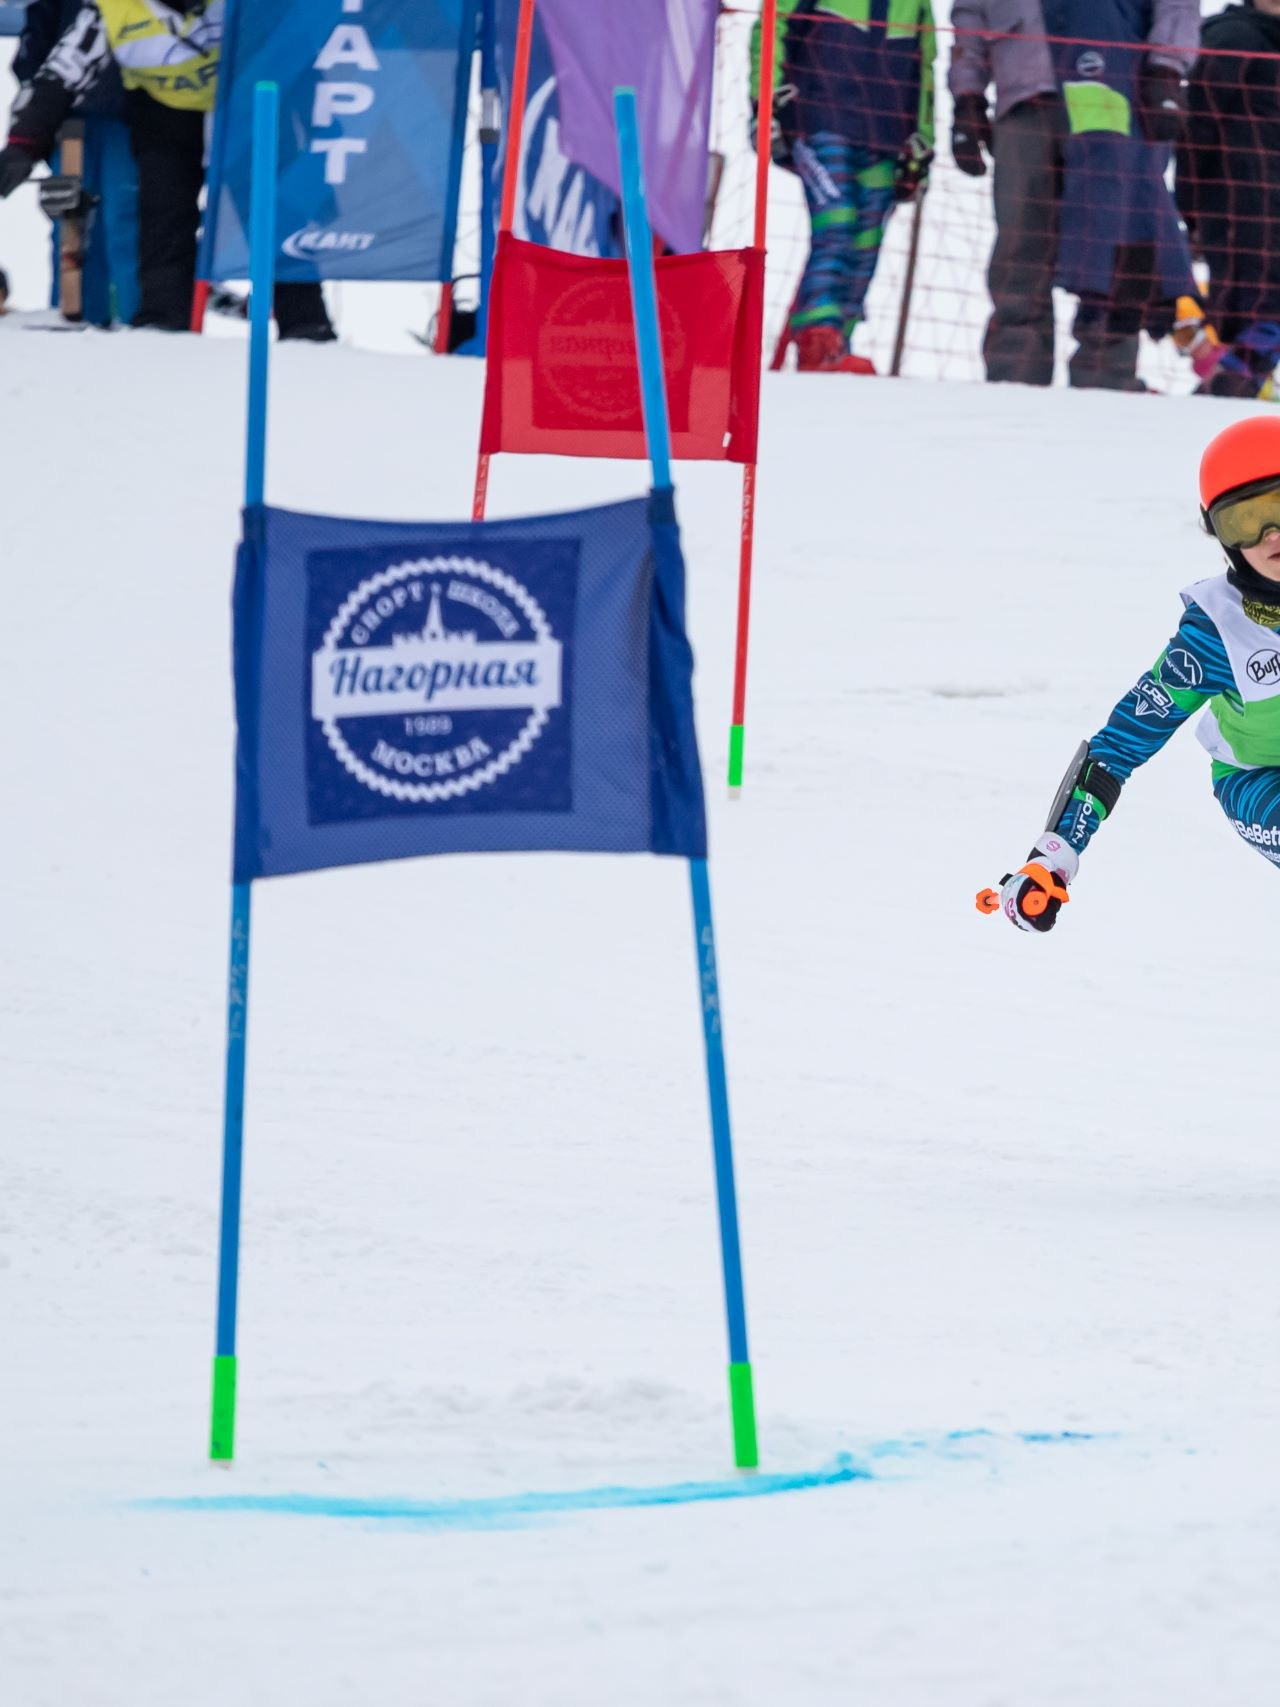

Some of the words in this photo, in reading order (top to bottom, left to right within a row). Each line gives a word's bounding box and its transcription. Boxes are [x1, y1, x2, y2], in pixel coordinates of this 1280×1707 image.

[311, 0, 382, 185] АРТ
[329, 655, 539, 702] Нагорная
[371, 735, 492, 777] МОСКВА
